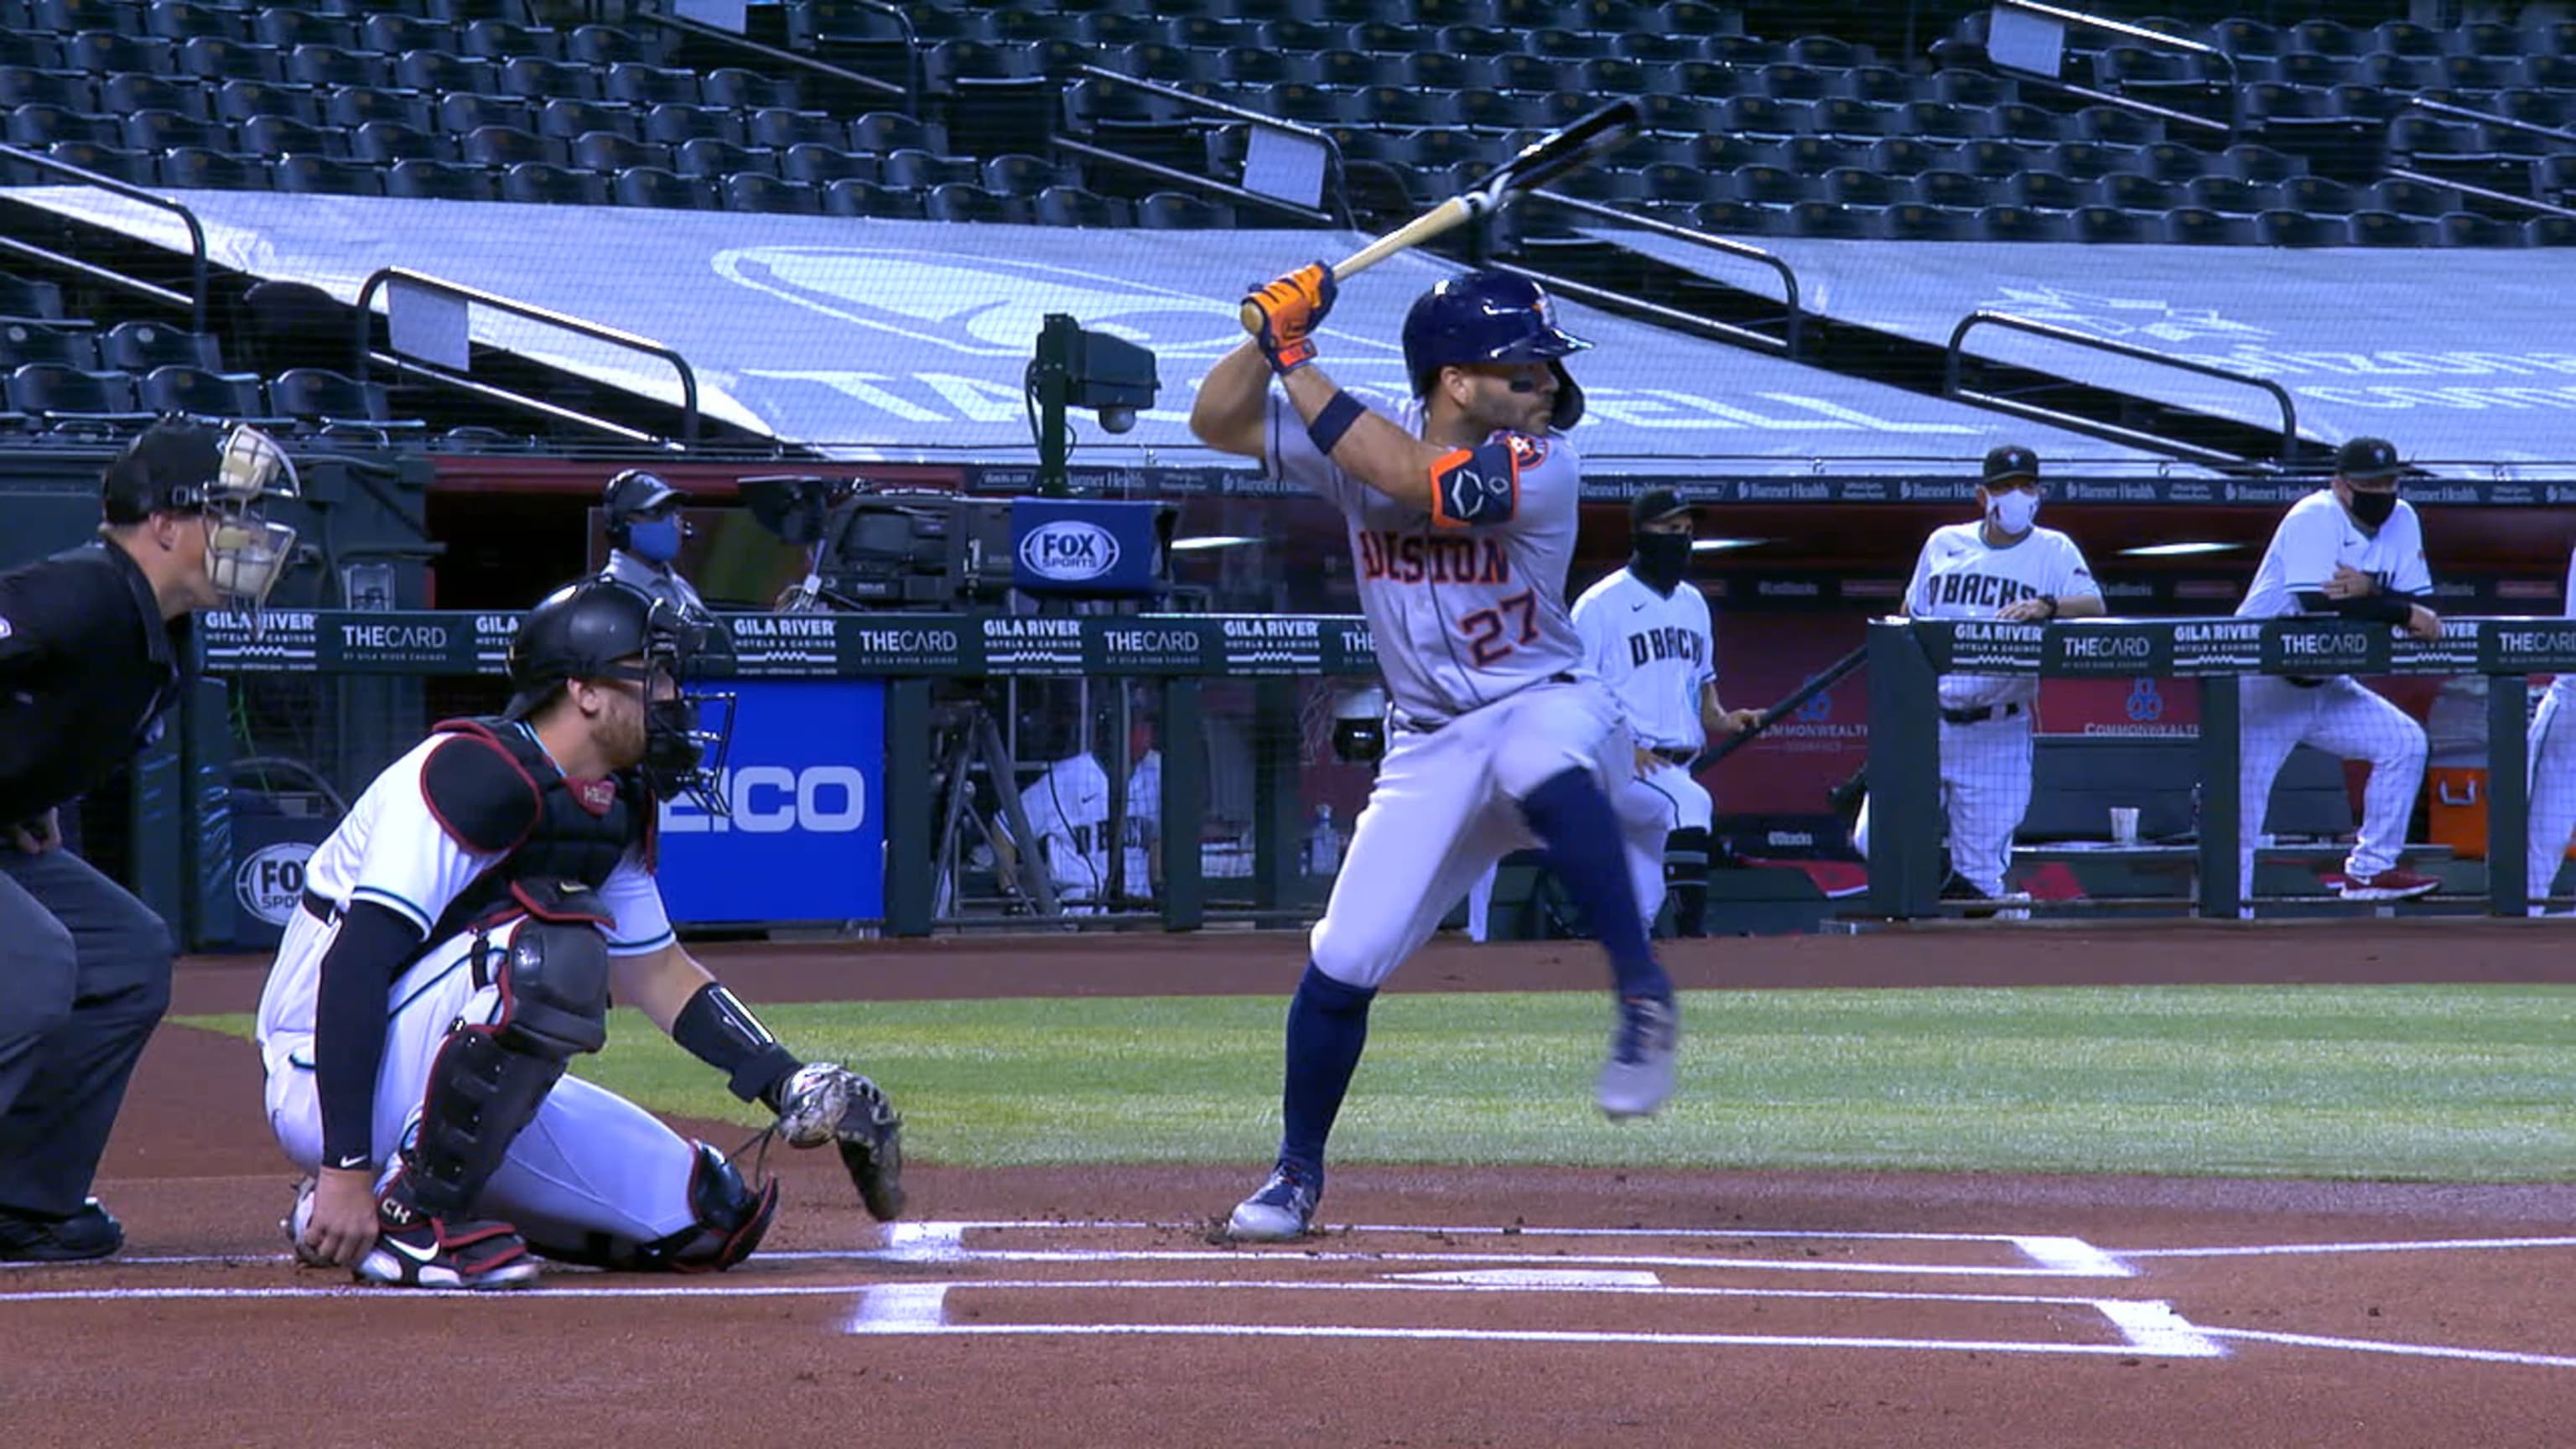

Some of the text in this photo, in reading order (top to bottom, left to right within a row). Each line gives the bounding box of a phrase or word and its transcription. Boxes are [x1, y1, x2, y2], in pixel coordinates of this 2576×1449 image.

[1043, 533, 1096, 557] FOX
[1042, 557, 1097, 569] SPORTS
[205, 611, 252, 629] GILA
[475, 616, 518, 633] GILA
[734, 619, 835, 636] GILA RIVER
[983, 620, 1081, 636] GILA RIVER
[1458, 587, 1540, 667] 27
[1224, 621, 1319, 637] GILA RIVER
[1954, 624, 2043, 641] GILA RIVER
[2174, 624, 2260, 641] GILA RIVER
[2441, 623, 2479, 638] IVER
[658, 766, 865, 832] EICO
[261, 860, 306, 894] FO
[261, 895, 302, 910] SPO
